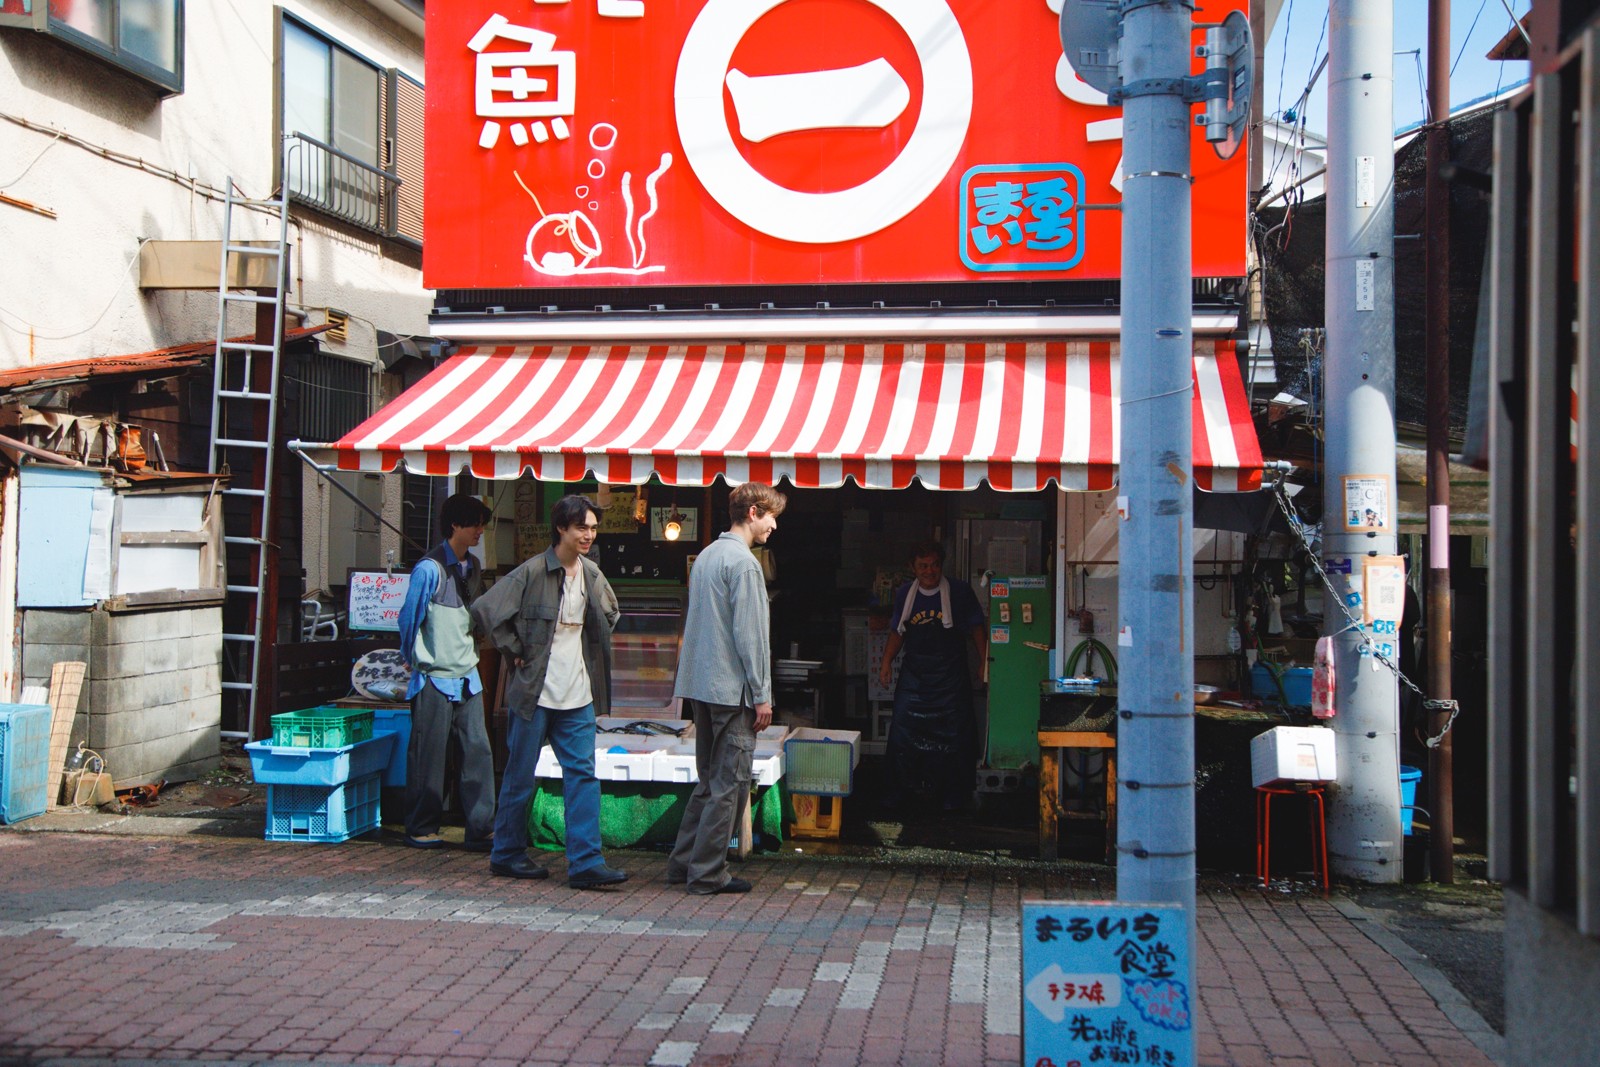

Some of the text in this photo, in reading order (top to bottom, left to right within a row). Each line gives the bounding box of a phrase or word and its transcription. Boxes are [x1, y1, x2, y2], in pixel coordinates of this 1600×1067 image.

[467, 13, 577, 149] 魚
[1035, 912, 1161, 942] まるいち
[1114, 939, 1176, 978] 食堂
[1135, 984, 1181, 1004] ペット
